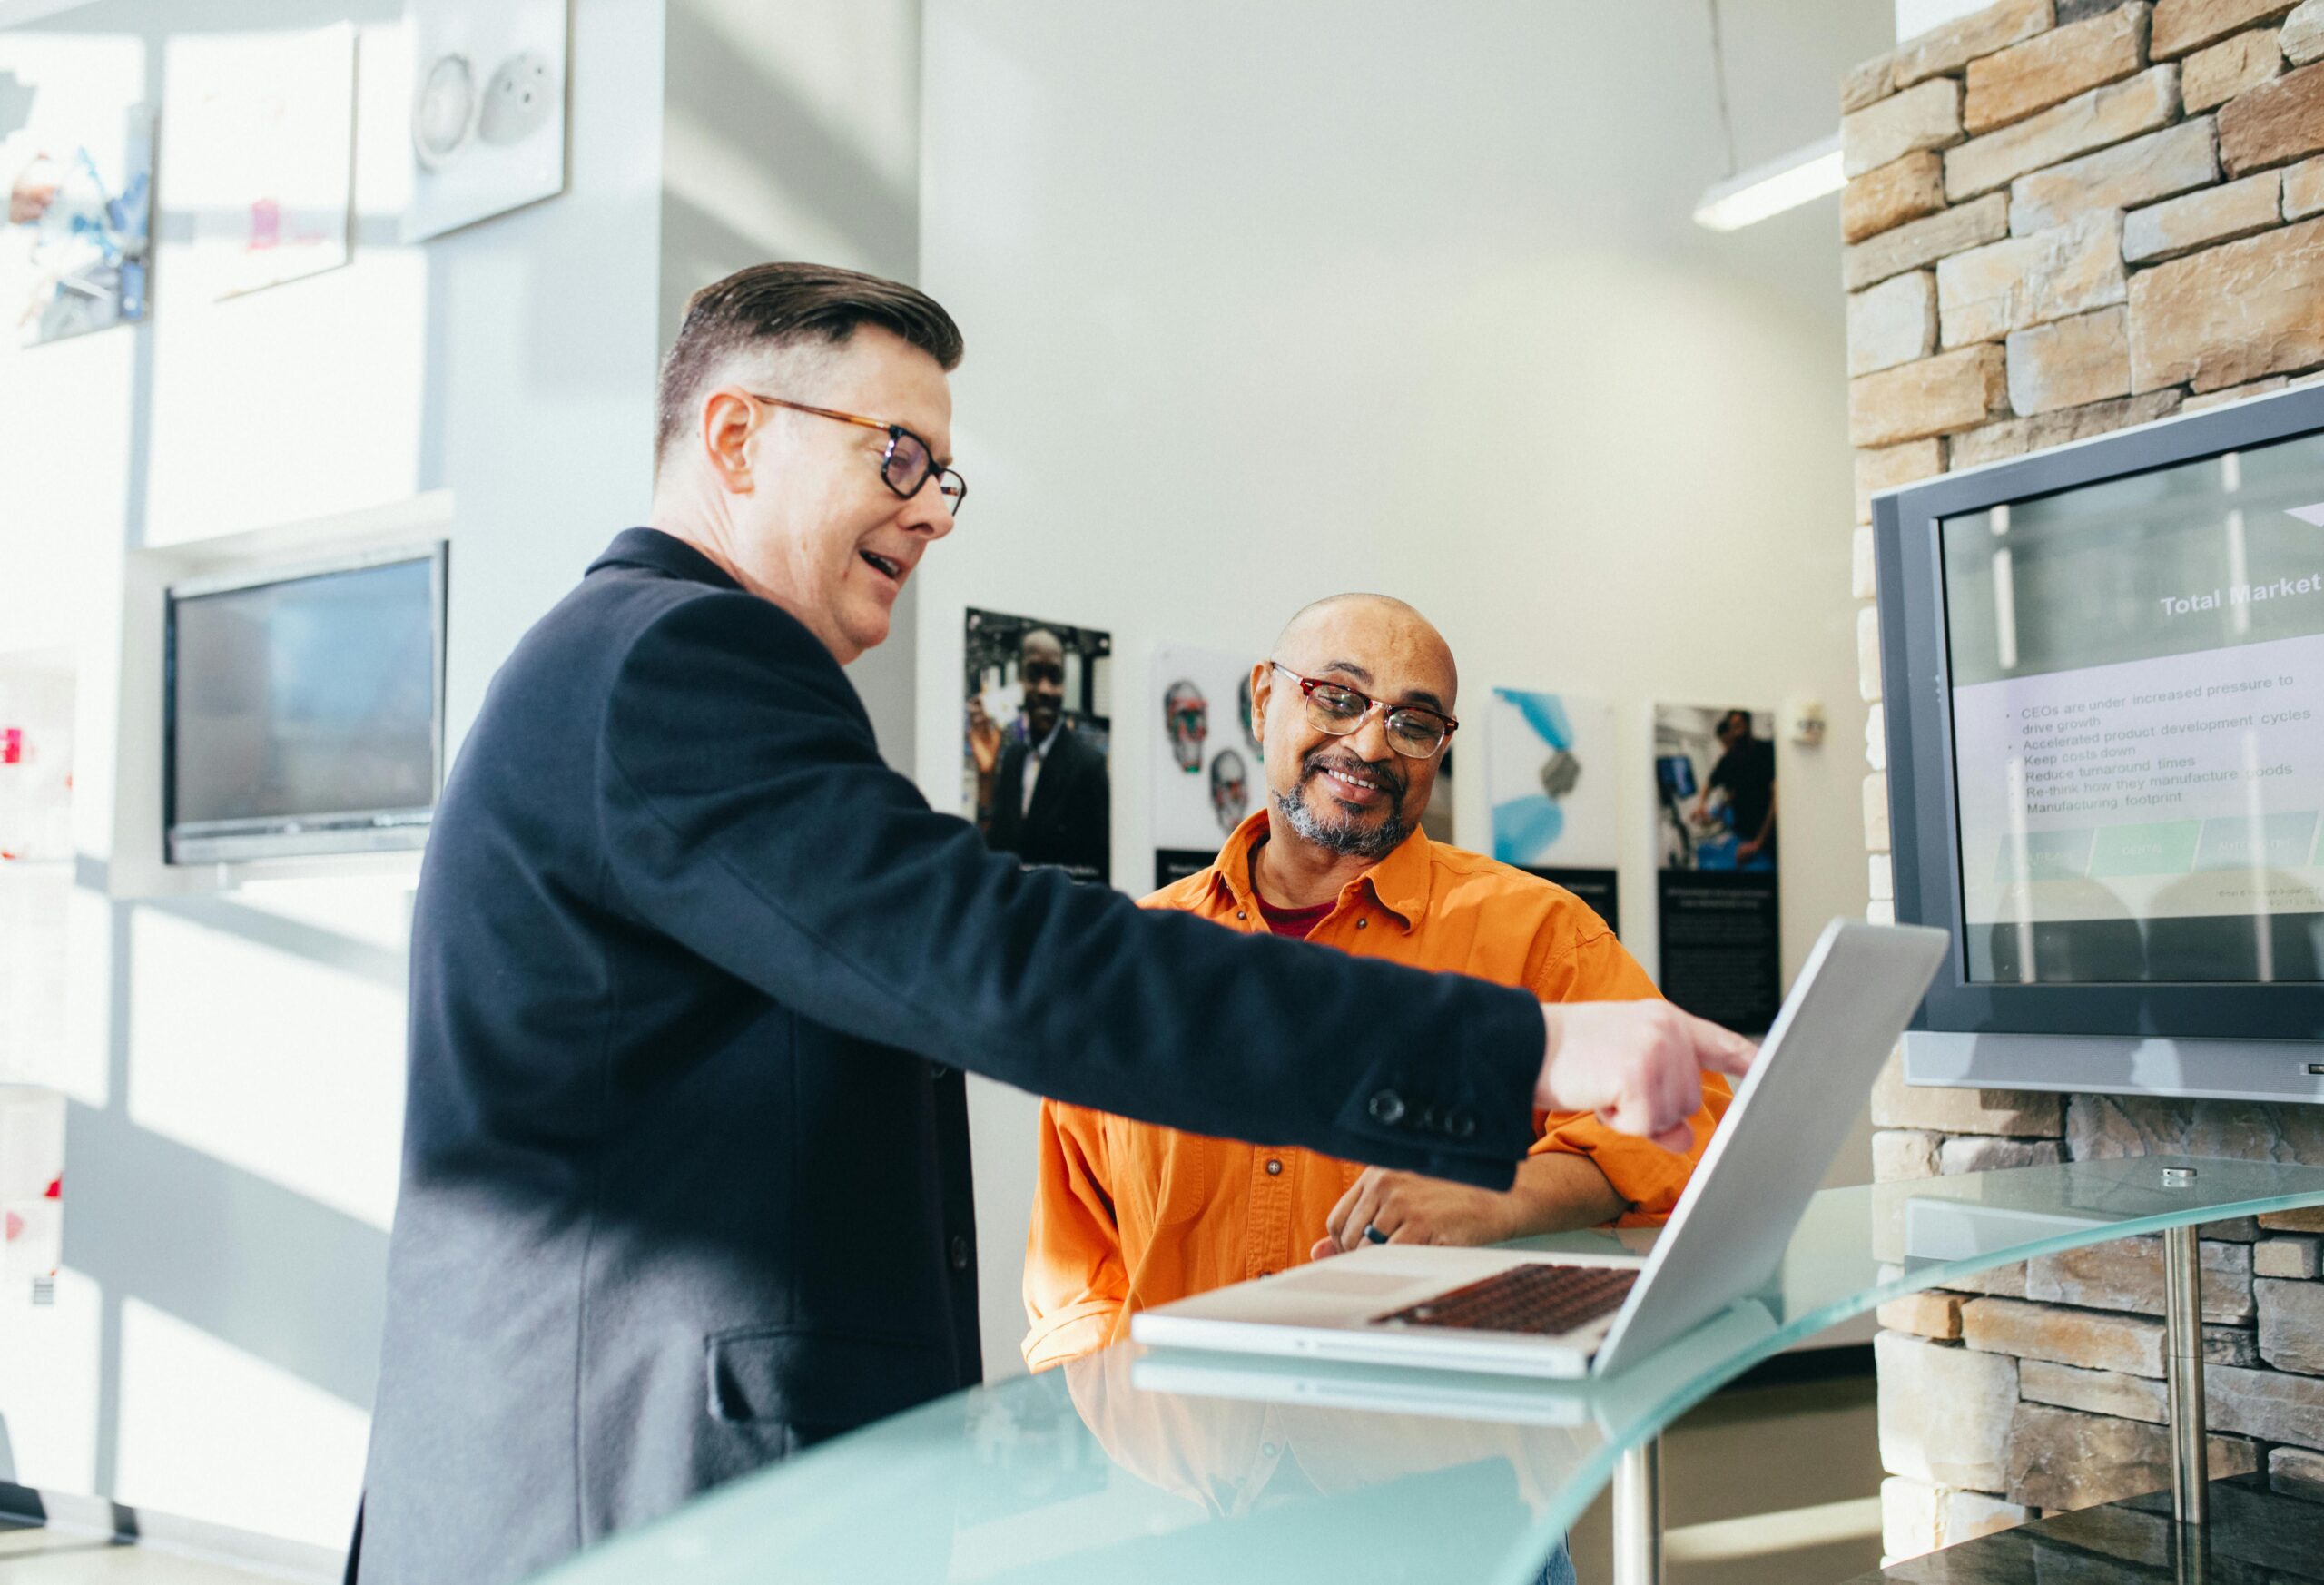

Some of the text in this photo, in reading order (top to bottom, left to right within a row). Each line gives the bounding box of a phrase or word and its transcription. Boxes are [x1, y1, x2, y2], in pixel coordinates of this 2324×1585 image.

[2160, 573, 2322, 616] Total Market
[2021, 675, 2294, 719] CEOs are under increased pressure to
[2022, 717, 2101, 735] drive growth
[2023, 709, 2312, 751] Accelerated product development cycles
[2024, 746, 2136, 767] Keep costs down
[2026, 757, 2196, 783] Reduce turnaround times
[2026, 784, 2079, 799] Re-think
[2083, 782, 2112, 792] how
[2116, 779, 2144, 792] they
[2149, 770, 2240, 787] manufacture
[2027, 792, 2182, 815] Manufacturing footprint
